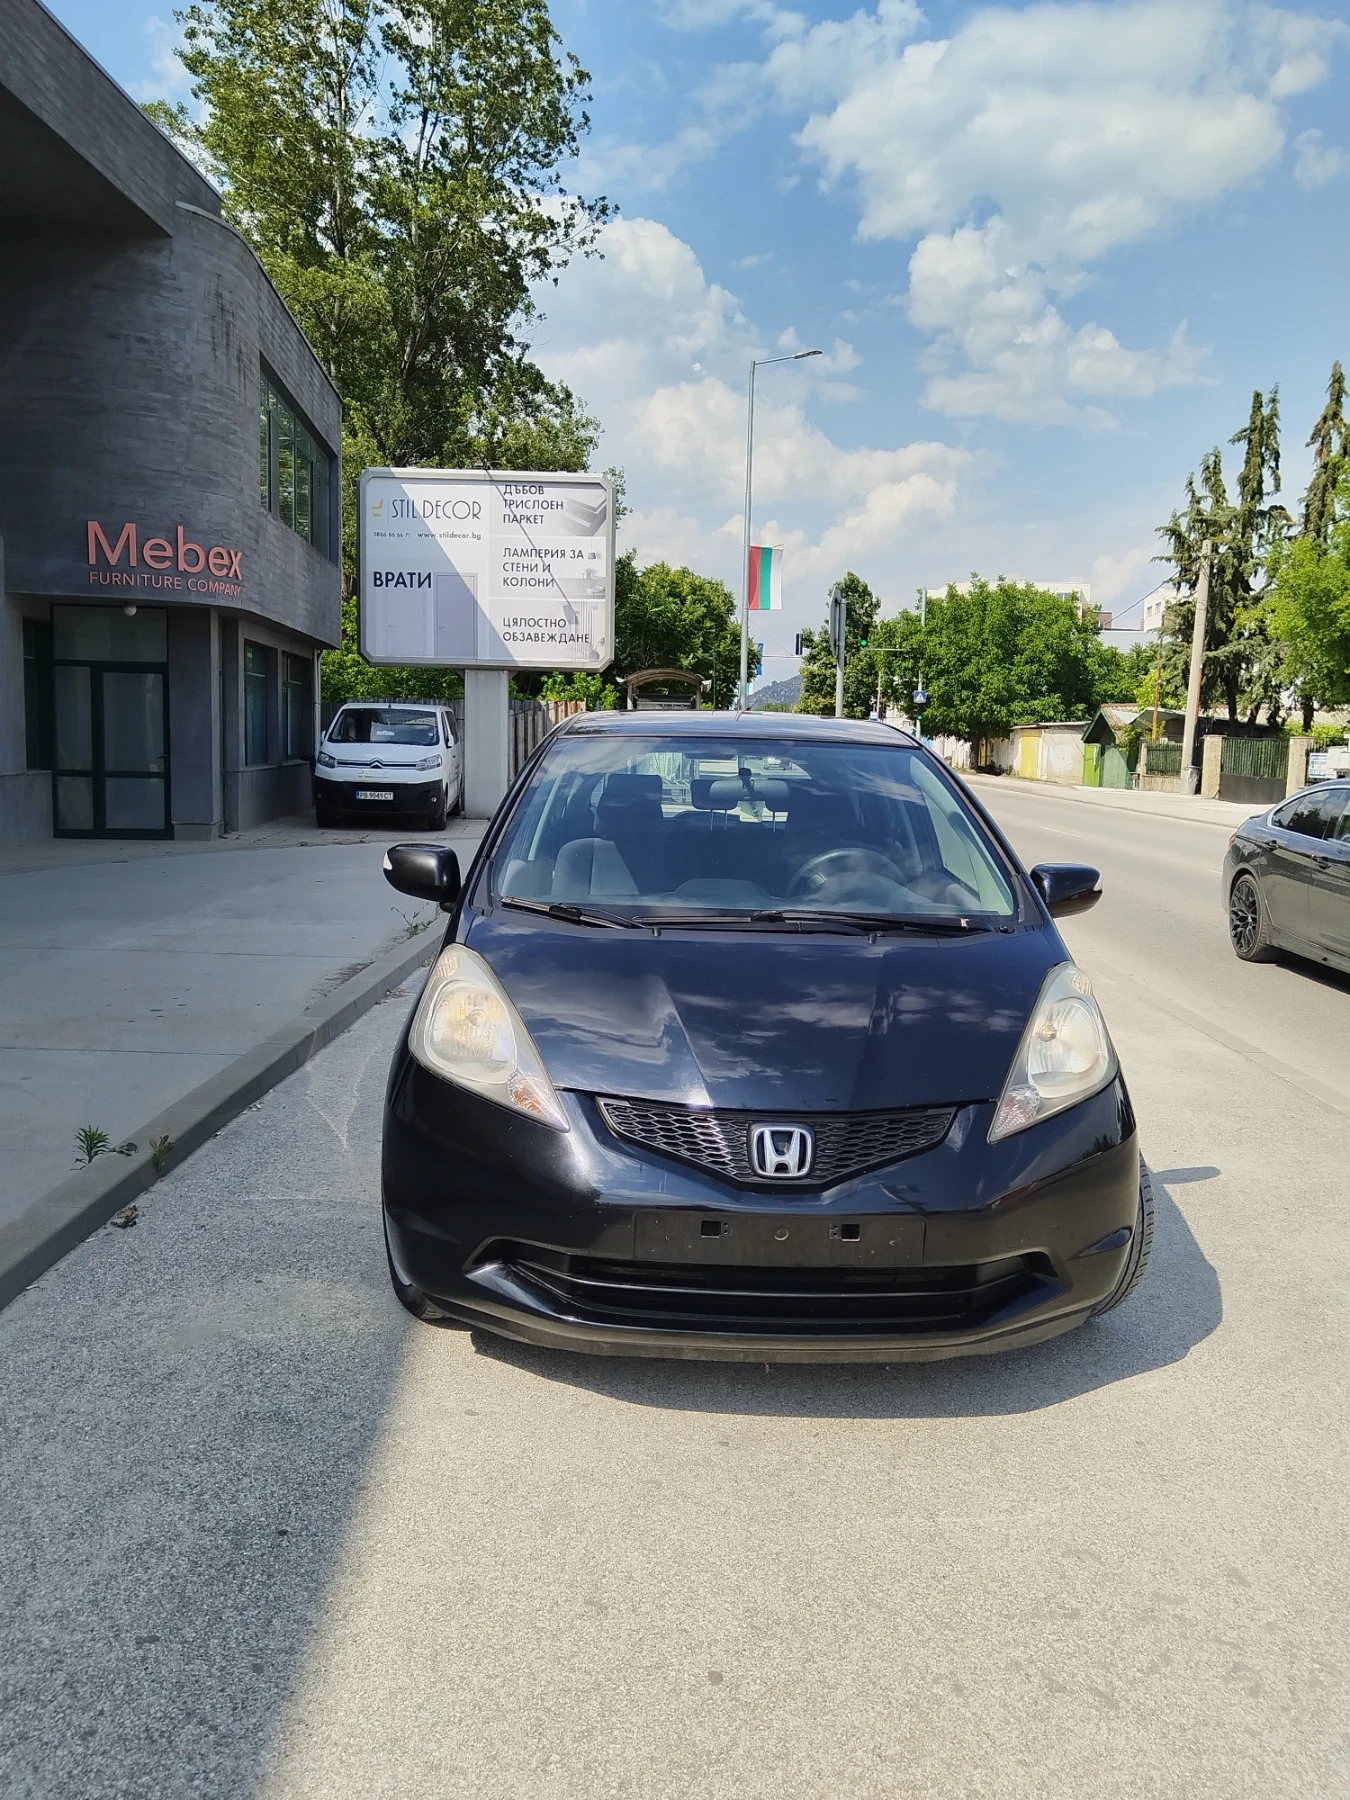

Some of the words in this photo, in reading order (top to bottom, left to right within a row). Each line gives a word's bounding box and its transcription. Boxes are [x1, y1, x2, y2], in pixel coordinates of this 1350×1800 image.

[503, 484, 545, 496] ДЪБОВ
[503, 499, 564, 510] ТРИСЛОЕН
[502, 513, 545, 525] ПАРКЕТ
[417, 531, 482, 541] www.stildecor.bg
[87, 520, 243, 581] Mebex
[502, 548, 566, 559] ЛАМПЕРИЯ
[569, 549, 585, 560] ЗА
[502, 562, 539, 573] СТЕНИ
[542, 563, 551, 574] И
[89, 571, 183, 590] FURNITURE
[187, 578, 242, 598] COMPANY
[373, 571, 432, 589] ВРАТИ
[502, 577, 555, 588] КОЛОНИ
[502, 617, 567, 630] ЦЯЛОСТНО
[502, 631, 591, 645] ОБЗАВЕЖДАНЕ
